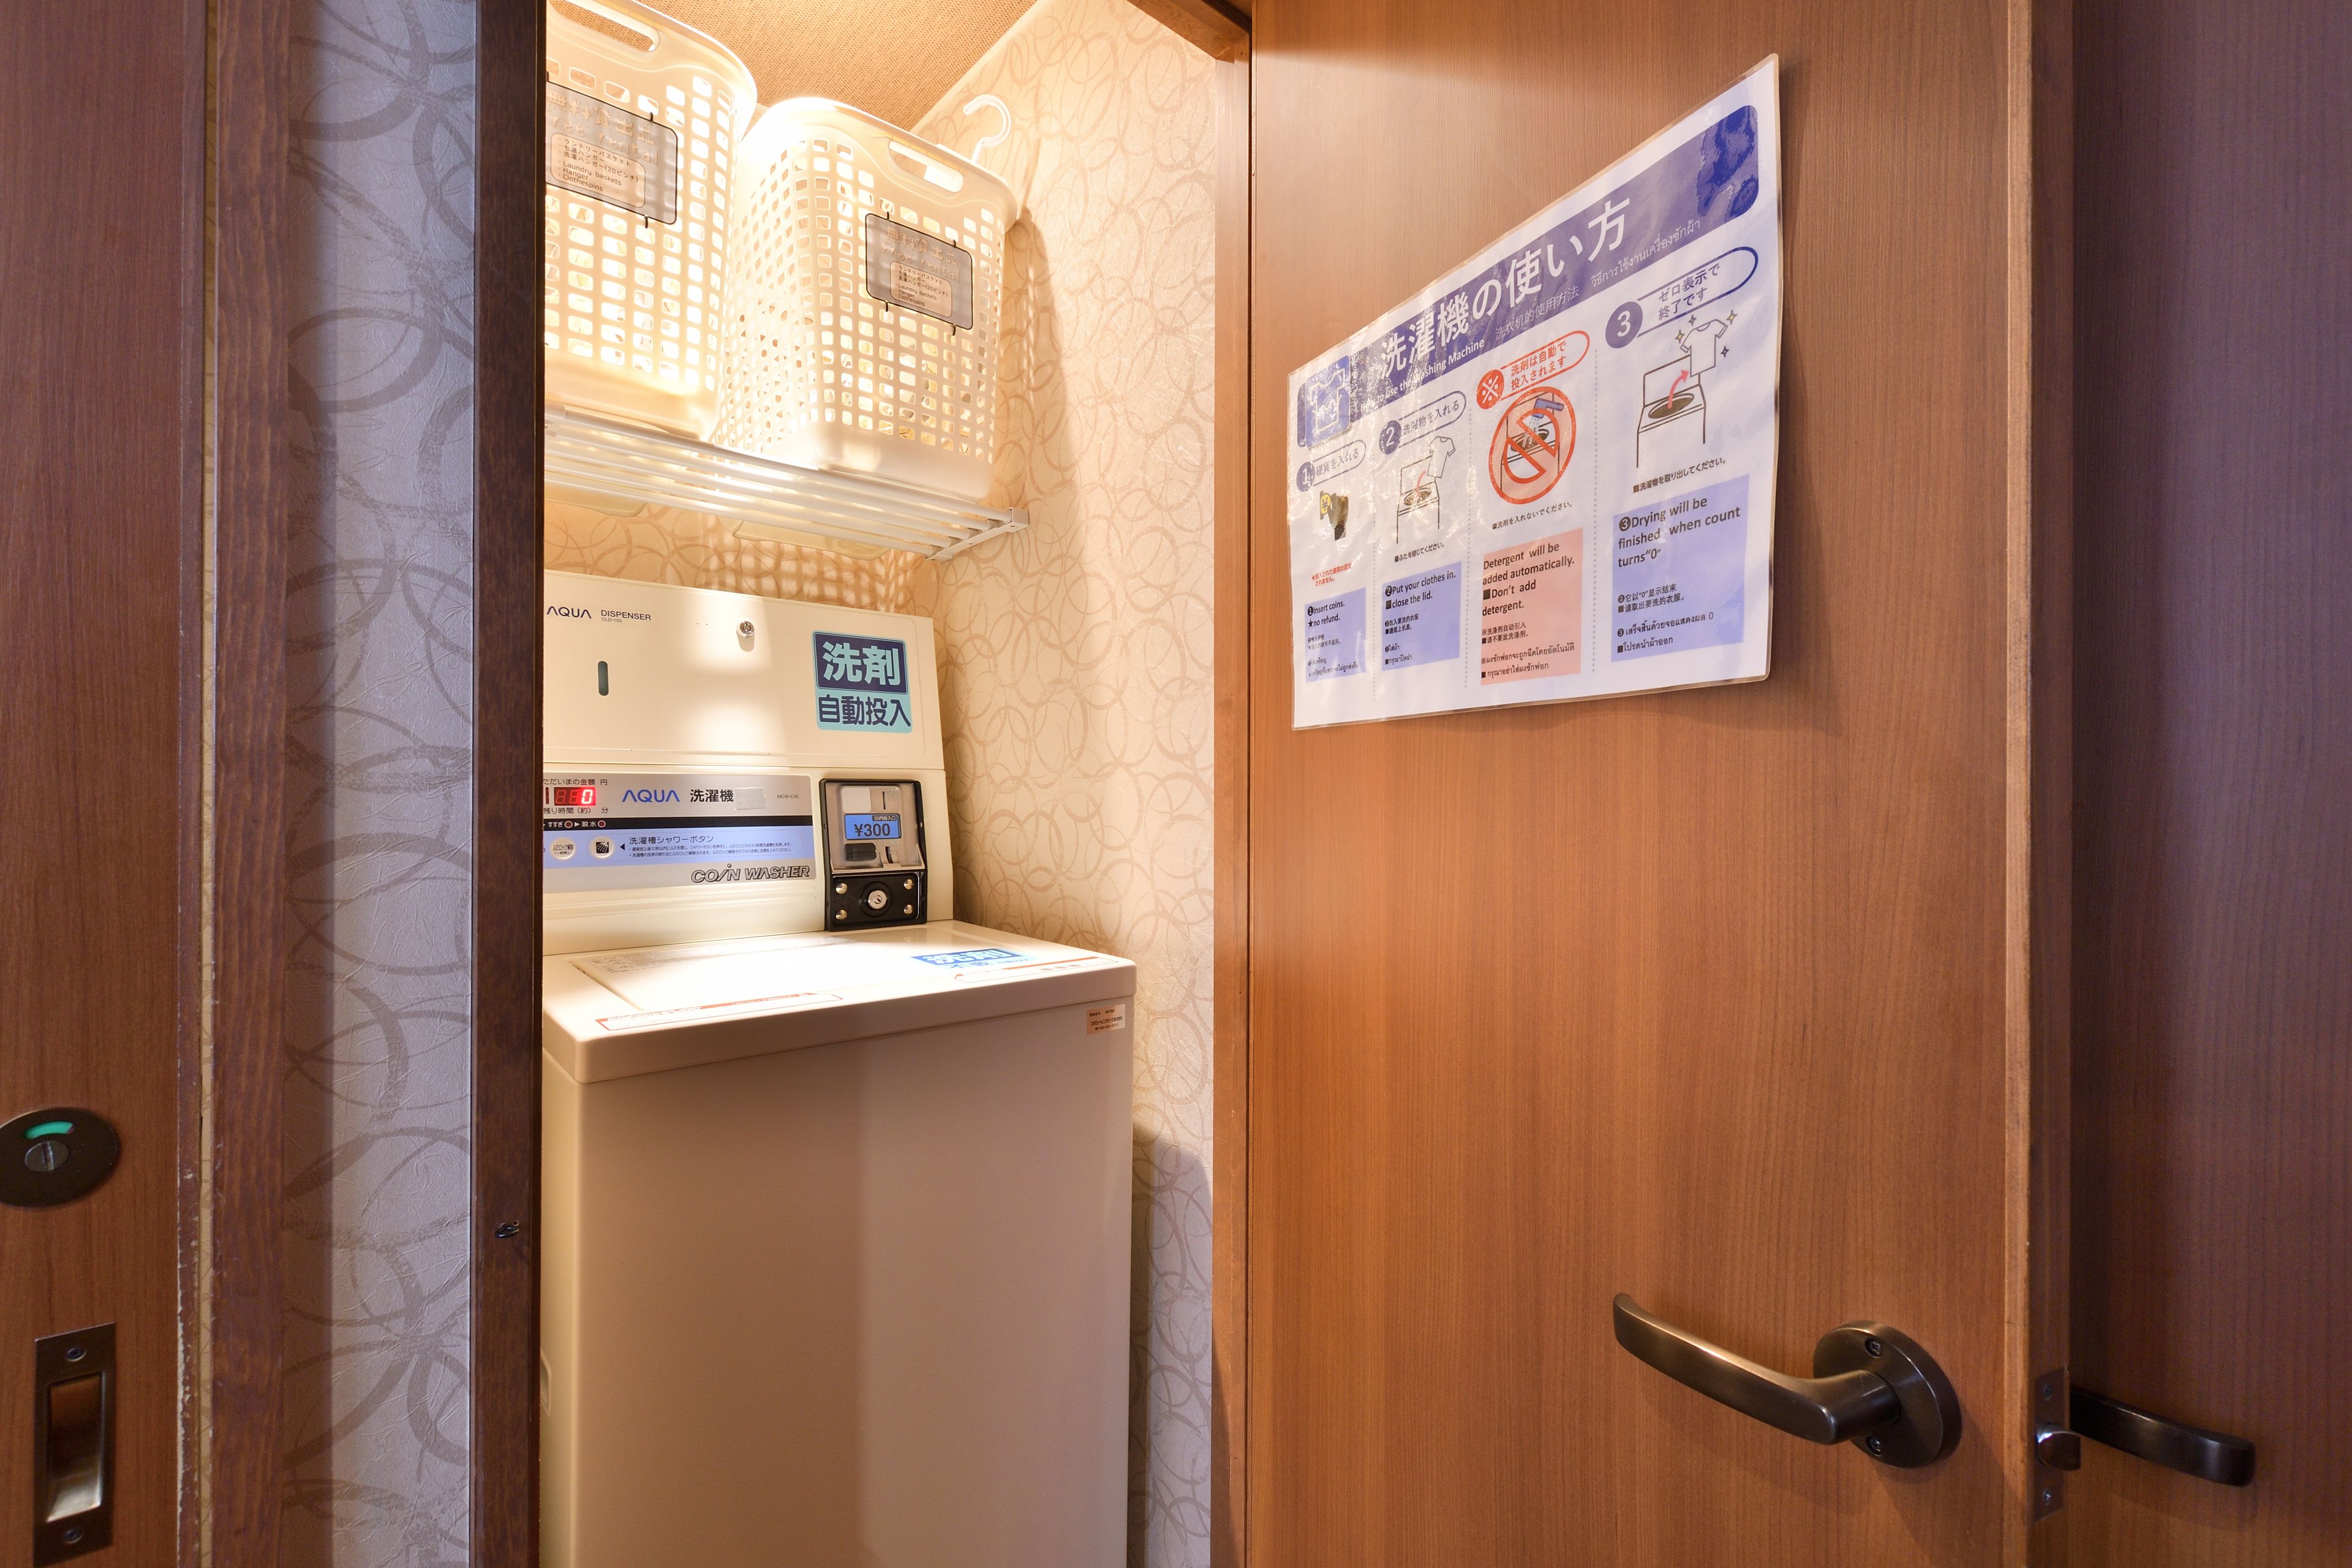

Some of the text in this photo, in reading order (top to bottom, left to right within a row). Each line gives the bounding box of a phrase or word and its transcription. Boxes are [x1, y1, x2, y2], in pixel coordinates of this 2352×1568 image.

[546, 115, 658, 165] ree rental
[565, 138, 631, 166] ランドリーバスケット
[563, 161, 622, 186] Laundry baskets
[563, 167, 589, 180] Hanger
[563, 175, 603, 191] Clothespins
[882, 242, 960, 283] Free rental
[898, 283, 937, 301] Laundry baskets
[898, 288, 915, 298] Hanger
[1381, 198, 1630, 380] 洗濯機の使い方
[1659, 263, 1720, 302] ゼロ表示で
[898, 293, 925, 306] Clothespins
[1659, 287, 1708, 321] 終了です
[1494, 285, 1580, 341] 洗衣机的使用方法
[1616, 311, 1631, 337] 3
[1385, 386, 1398, 399] use
[1400, 380, 1411, 392] the
[1412, 359, 1446, 383] Washing
[1448, 339, 1485, 364] Machine
[1511, 341, 1566, 377] 洗剤は自動で
[1510, 355, 1567, 391] 投入されます
[1385, 427, 1395, 447] 2
[1640, 458, 1726, 491] 洗濯物を取り出してください。
[1669, 500, 1689, 516] will
[1693, 497, 1707, 510] be
[1618, 507, 1740, 549] finished when count
[1483, 543, 1559, 570] Detergent will be
[1404, 581, 1420, 593] your
[1421, 574, 1445, 587] clothes
[1447, 571, 1456, 579] in.
[1483, 556, 1574, 585] added automatically.
[1392, 590, 1433, 608] close the lid.
[1492, 579, 1536, 598] Don’t add
[546, 606, 651, 620] AQUA DISPENSER
[1314, 604, 1328, 614] Insert
[1329, 601, 1345, 609] coins.
[1321, 613, 1340, 625] refund.
[1482, 600, 1524, 616] detergent.
[823, 641, 900, 685] 洗剤
[818, 694, 911, 726] 自動投入
[622, 789, 734, 802] AQUA 洗濯機
[629, 835, 714, 845] 洗濯槽シャワーボタン
[854, 823, 891, 837] ¥300
[691, 863, 810, 883] COIN WASHER
